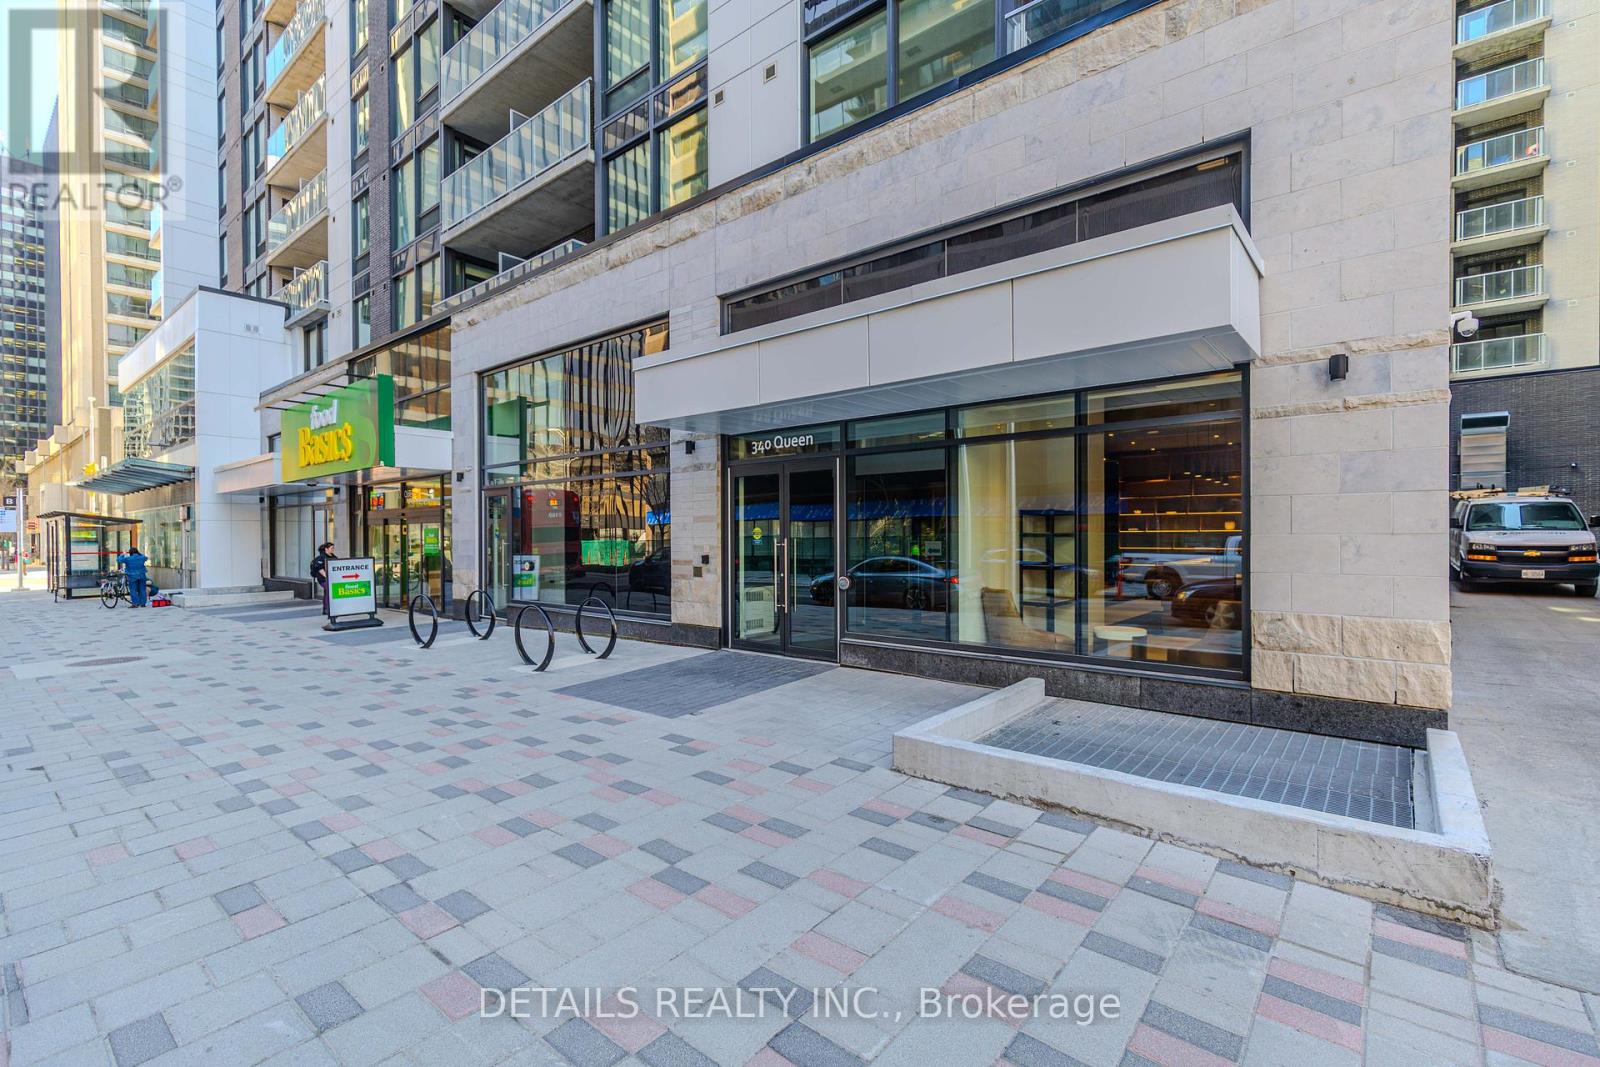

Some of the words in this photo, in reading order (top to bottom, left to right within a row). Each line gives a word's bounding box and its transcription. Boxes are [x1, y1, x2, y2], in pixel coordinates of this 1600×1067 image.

[310, 399, 338, 431] food
[751, 440, 772, 455] 340
[773, 434, 814, 449] Queen
[331, 564, 369, 572] ENTRANCE
